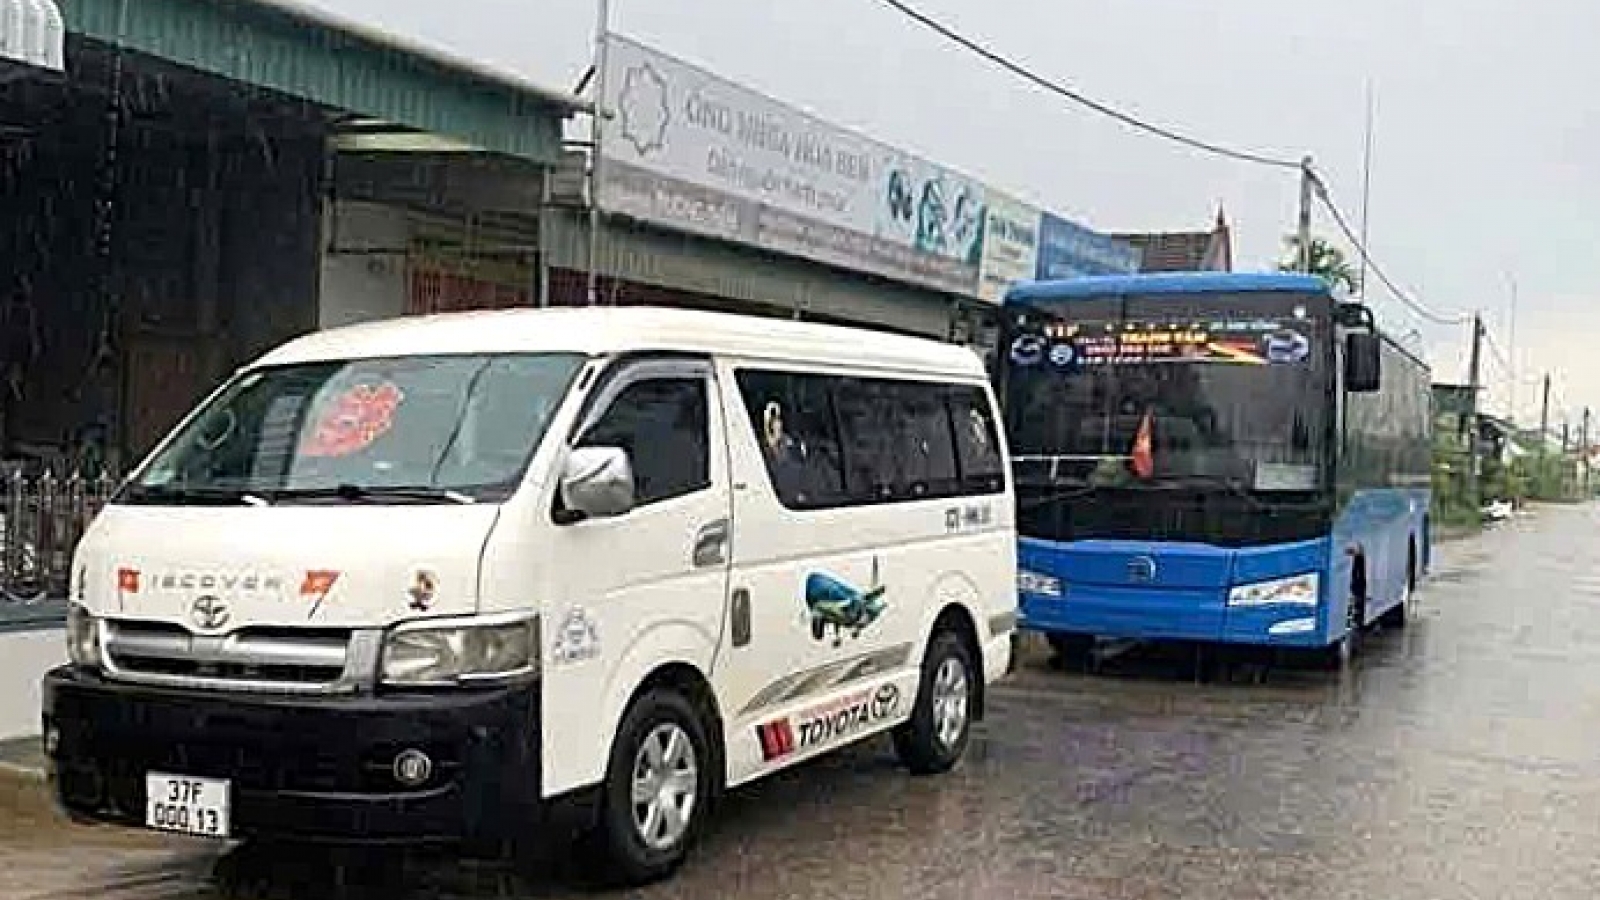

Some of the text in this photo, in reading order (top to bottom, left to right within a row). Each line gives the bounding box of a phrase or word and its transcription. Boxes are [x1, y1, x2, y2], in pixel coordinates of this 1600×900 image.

[799, 702, 869, 747] TOYOTA
[167, 780, 203, 805] 37F
[154, 803, 219, 832] 000.13
